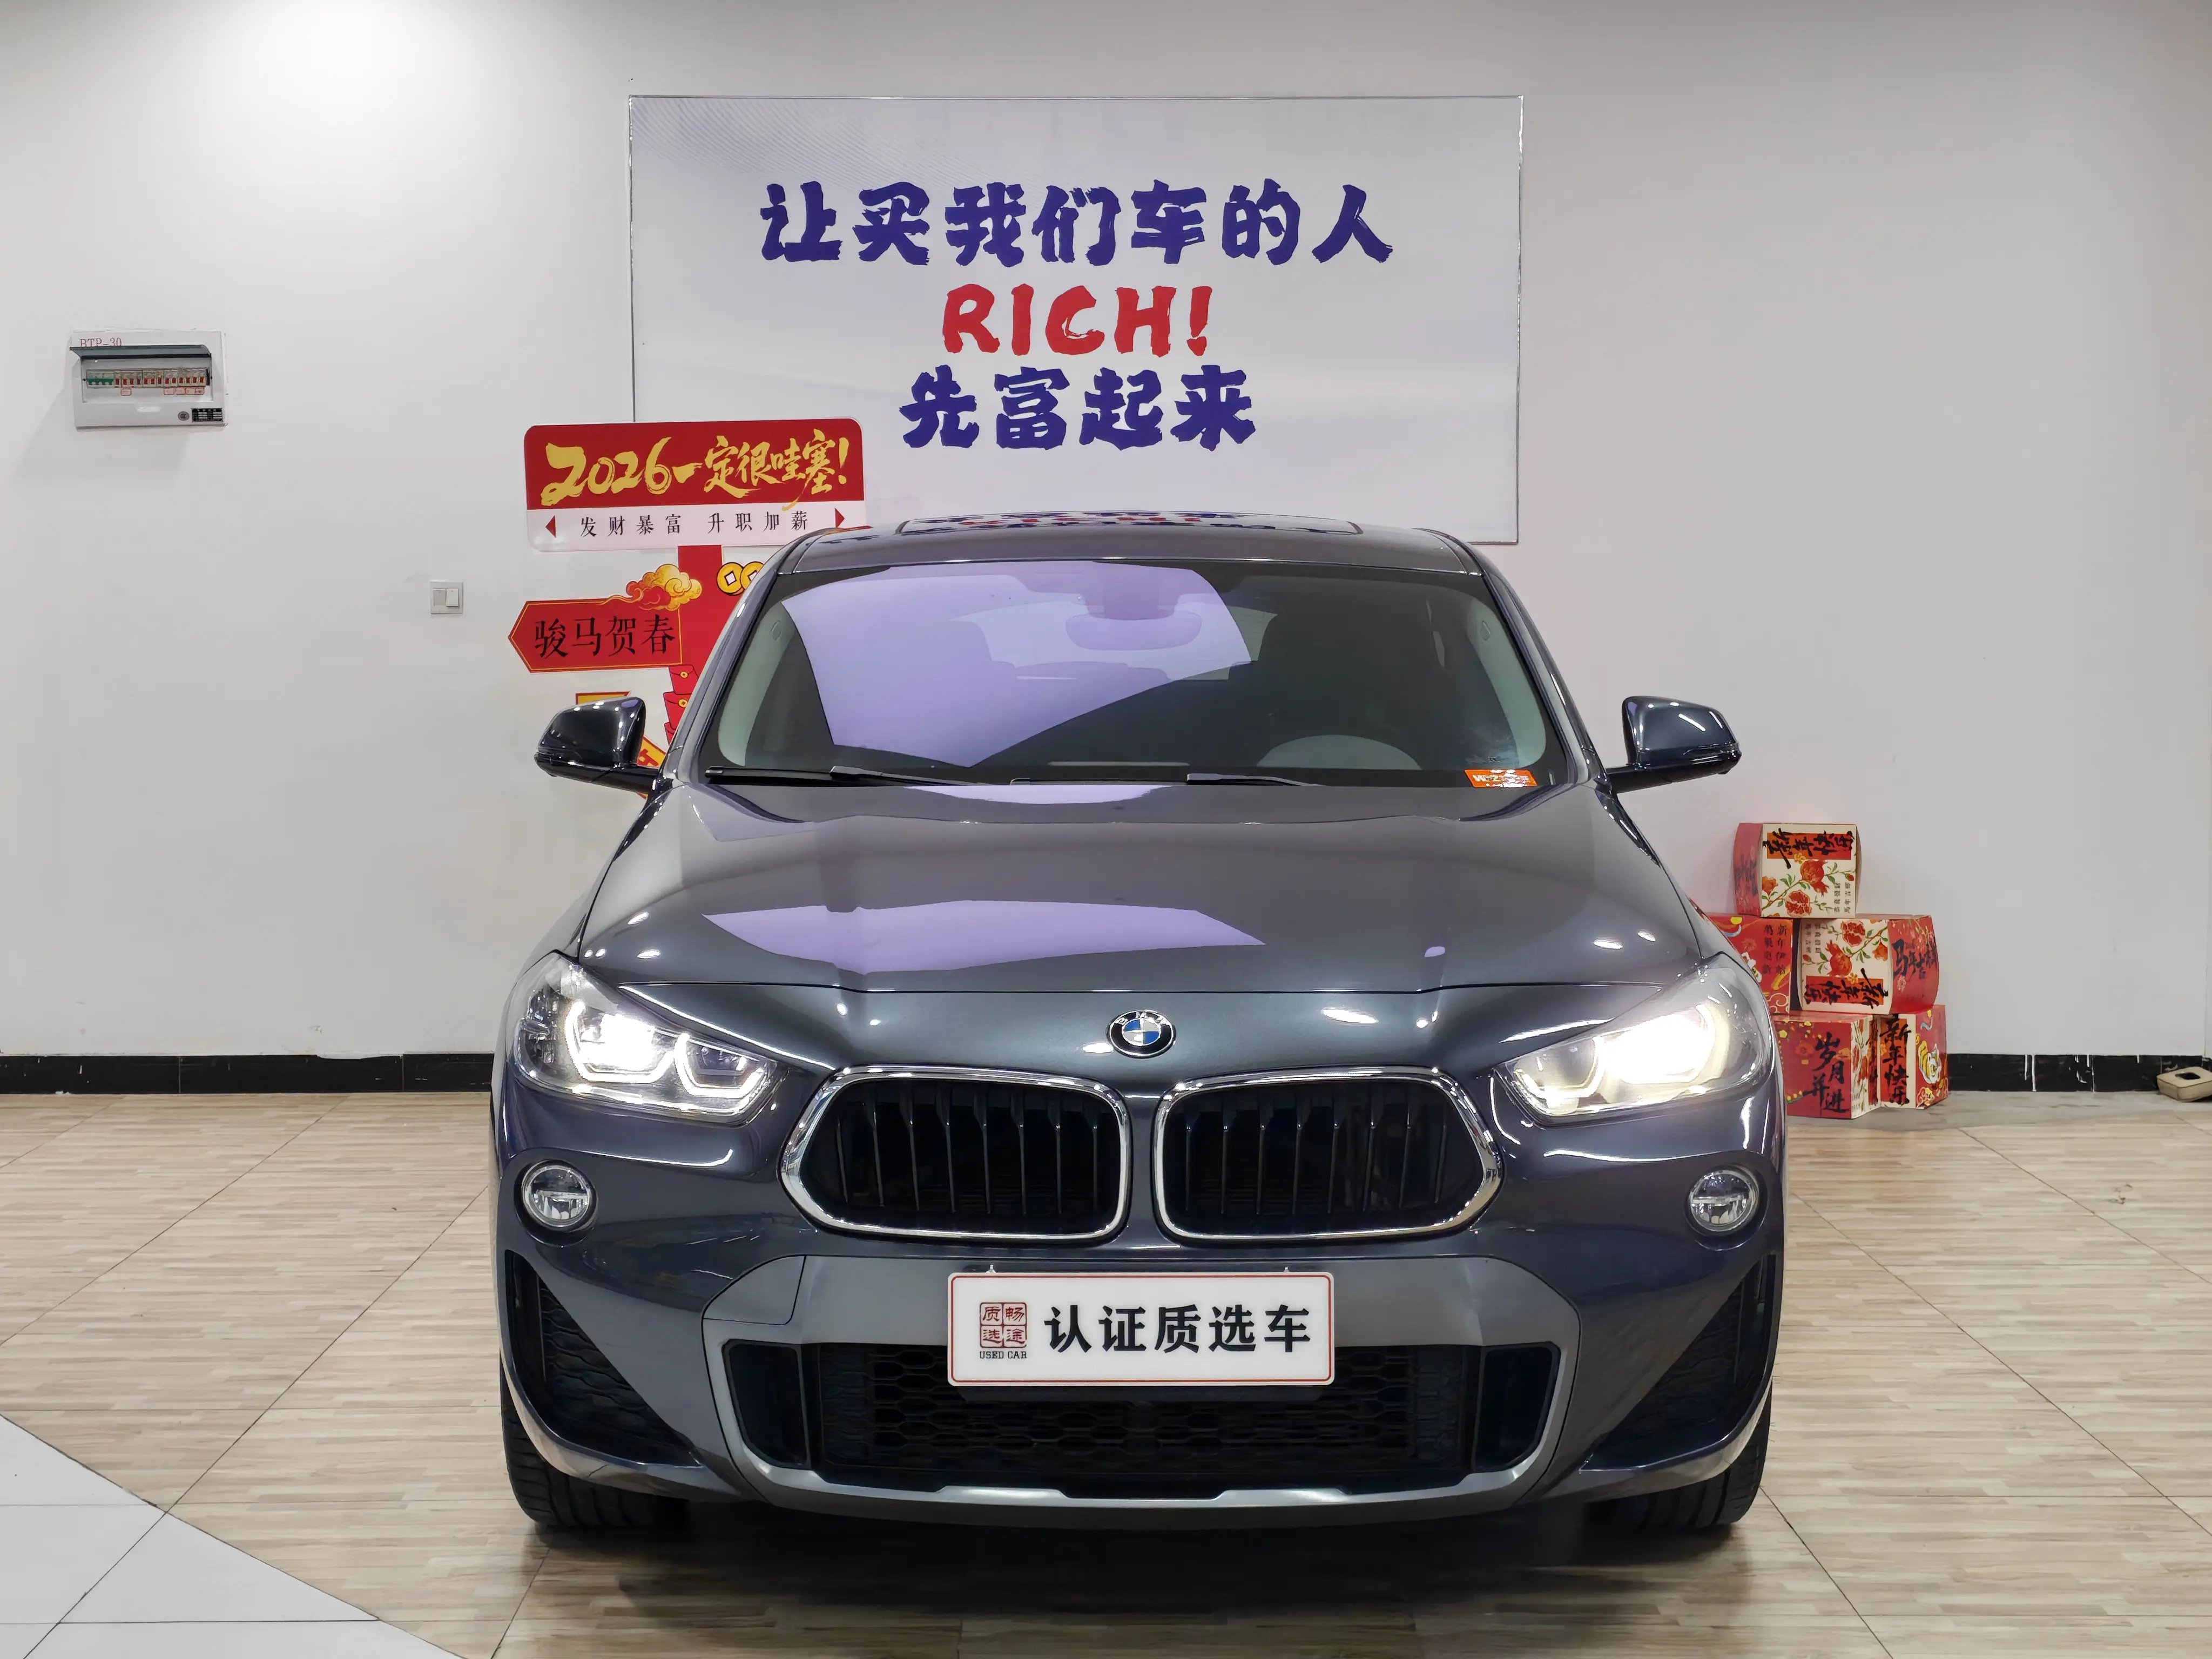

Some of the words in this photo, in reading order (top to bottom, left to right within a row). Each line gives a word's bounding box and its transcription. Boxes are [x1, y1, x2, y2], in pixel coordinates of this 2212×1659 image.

[761, 179, 1392, 267] 让买我们车的人
[942, 284, 1212, 356] RICH!
[899, 365, 1256, 450] 先富起来
[581, 513, 682, 537] 发财暴富
[707, 510, 808, 534] 升职加薪
[534, 614, 676, 658] 骏马贺春
[1044, 1304, 1311, 1354] 认证质选车
